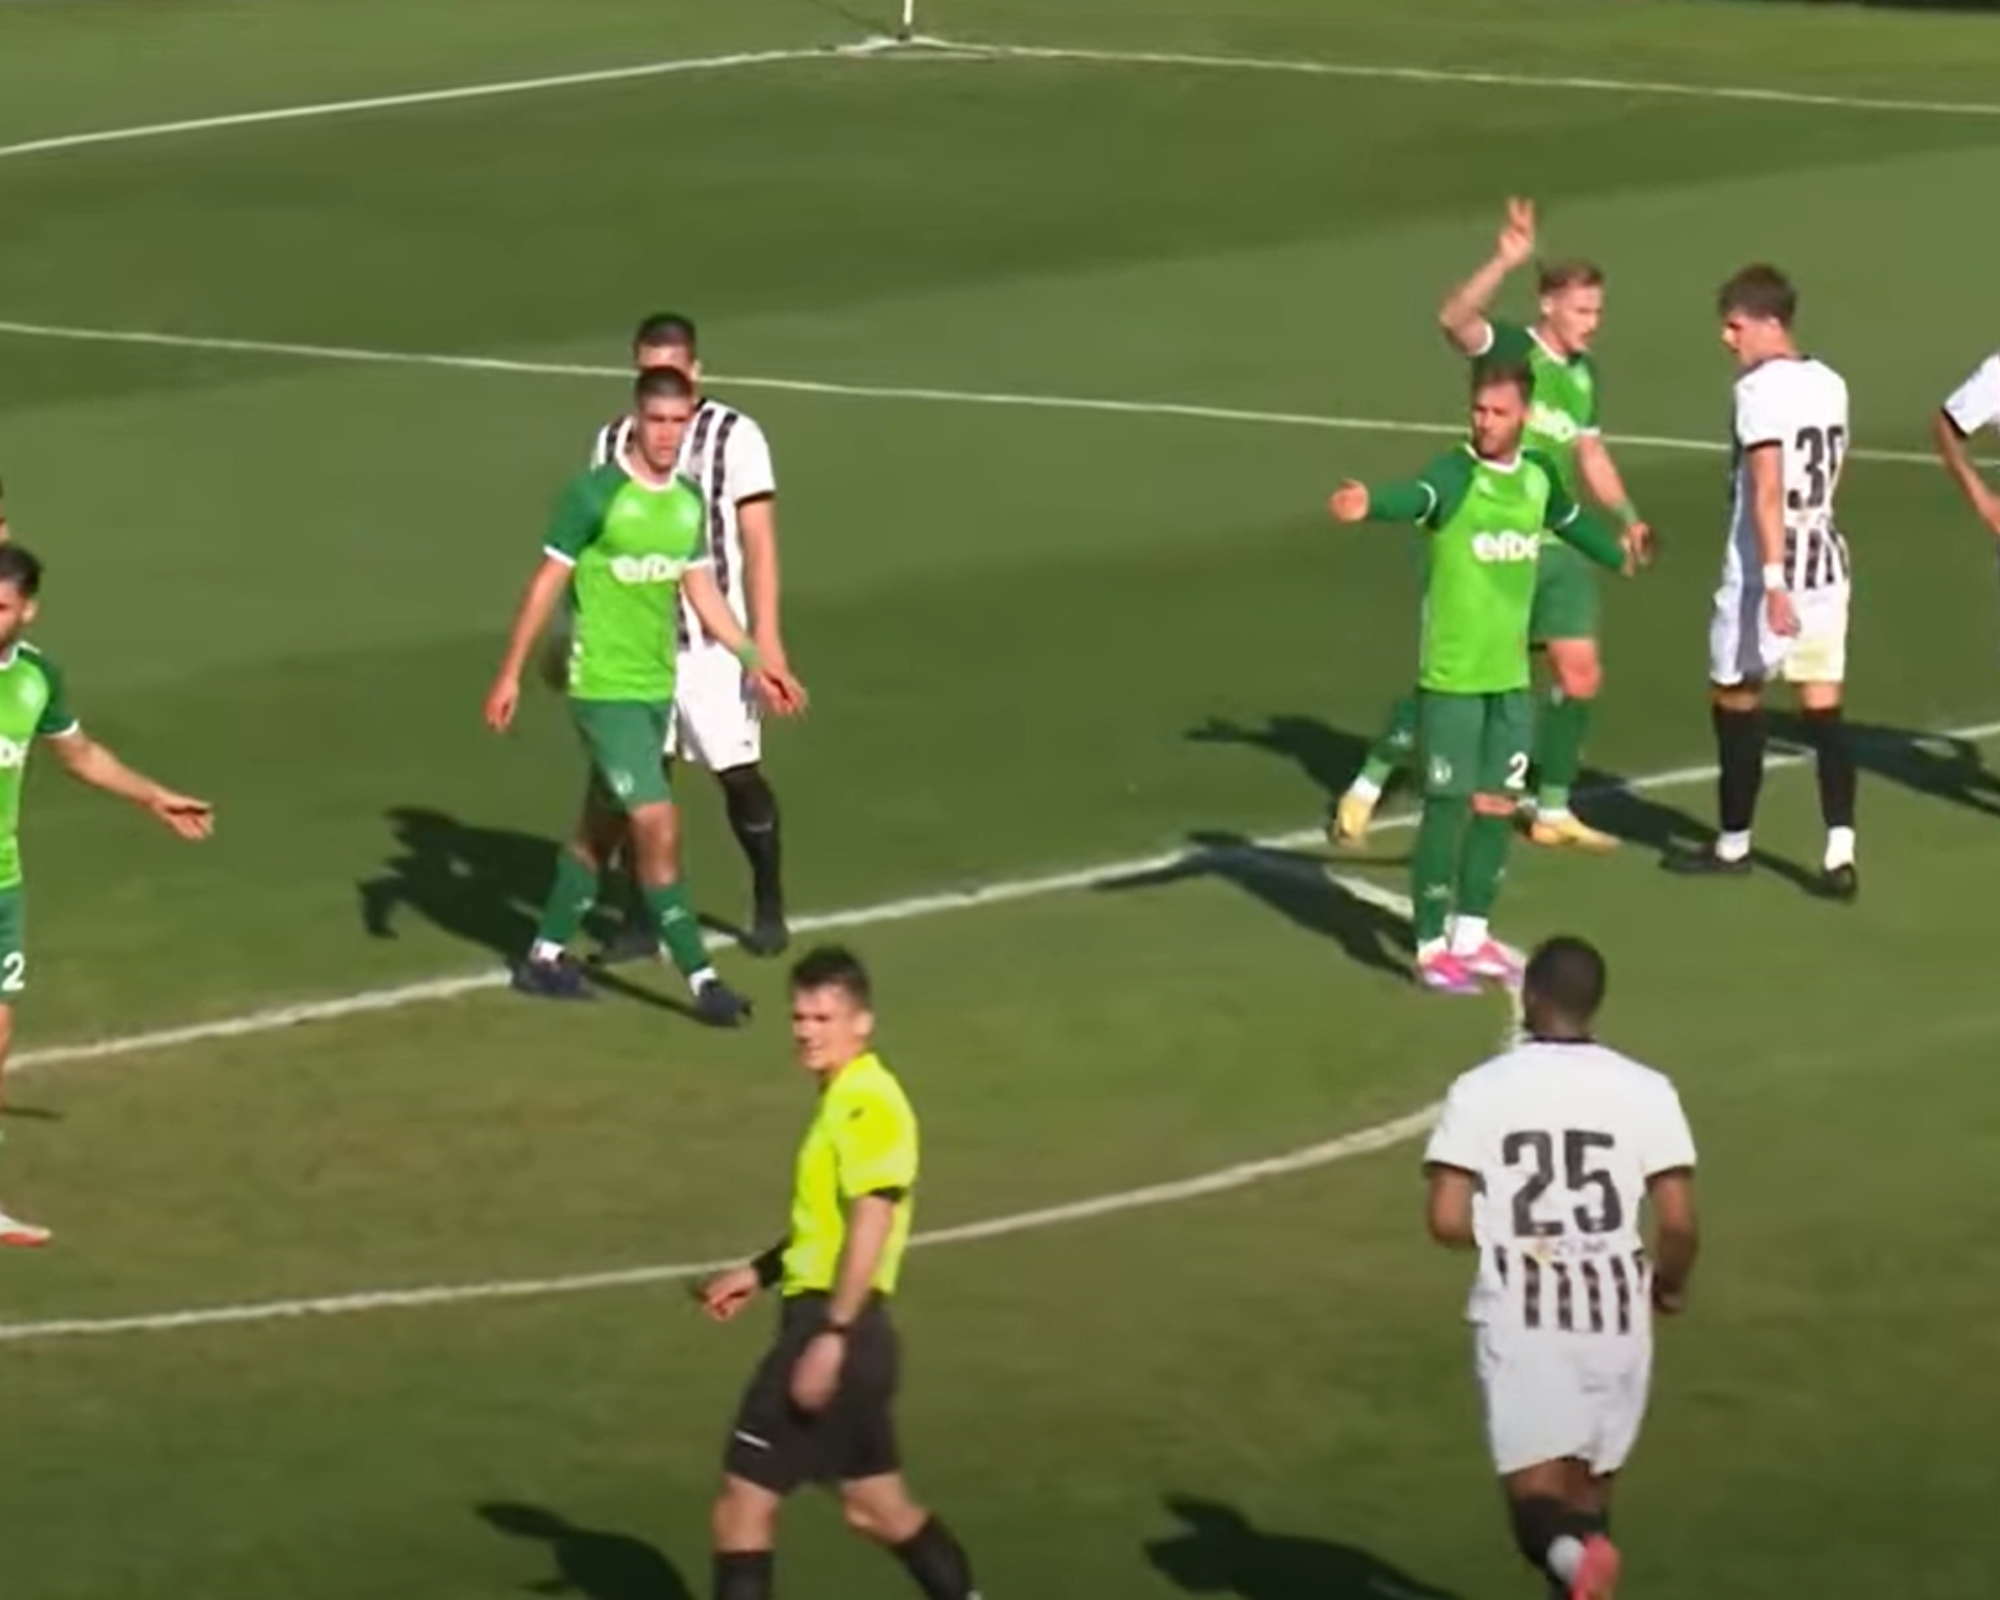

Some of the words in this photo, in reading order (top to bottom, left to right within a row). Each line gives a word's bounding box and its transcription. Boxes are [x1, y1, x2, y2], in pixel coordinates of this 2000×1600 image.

[1504, 751, 1529, 789] 2
[2, 951, 25, 991] 2
[1502, 1129, 1622, 1237] 25
